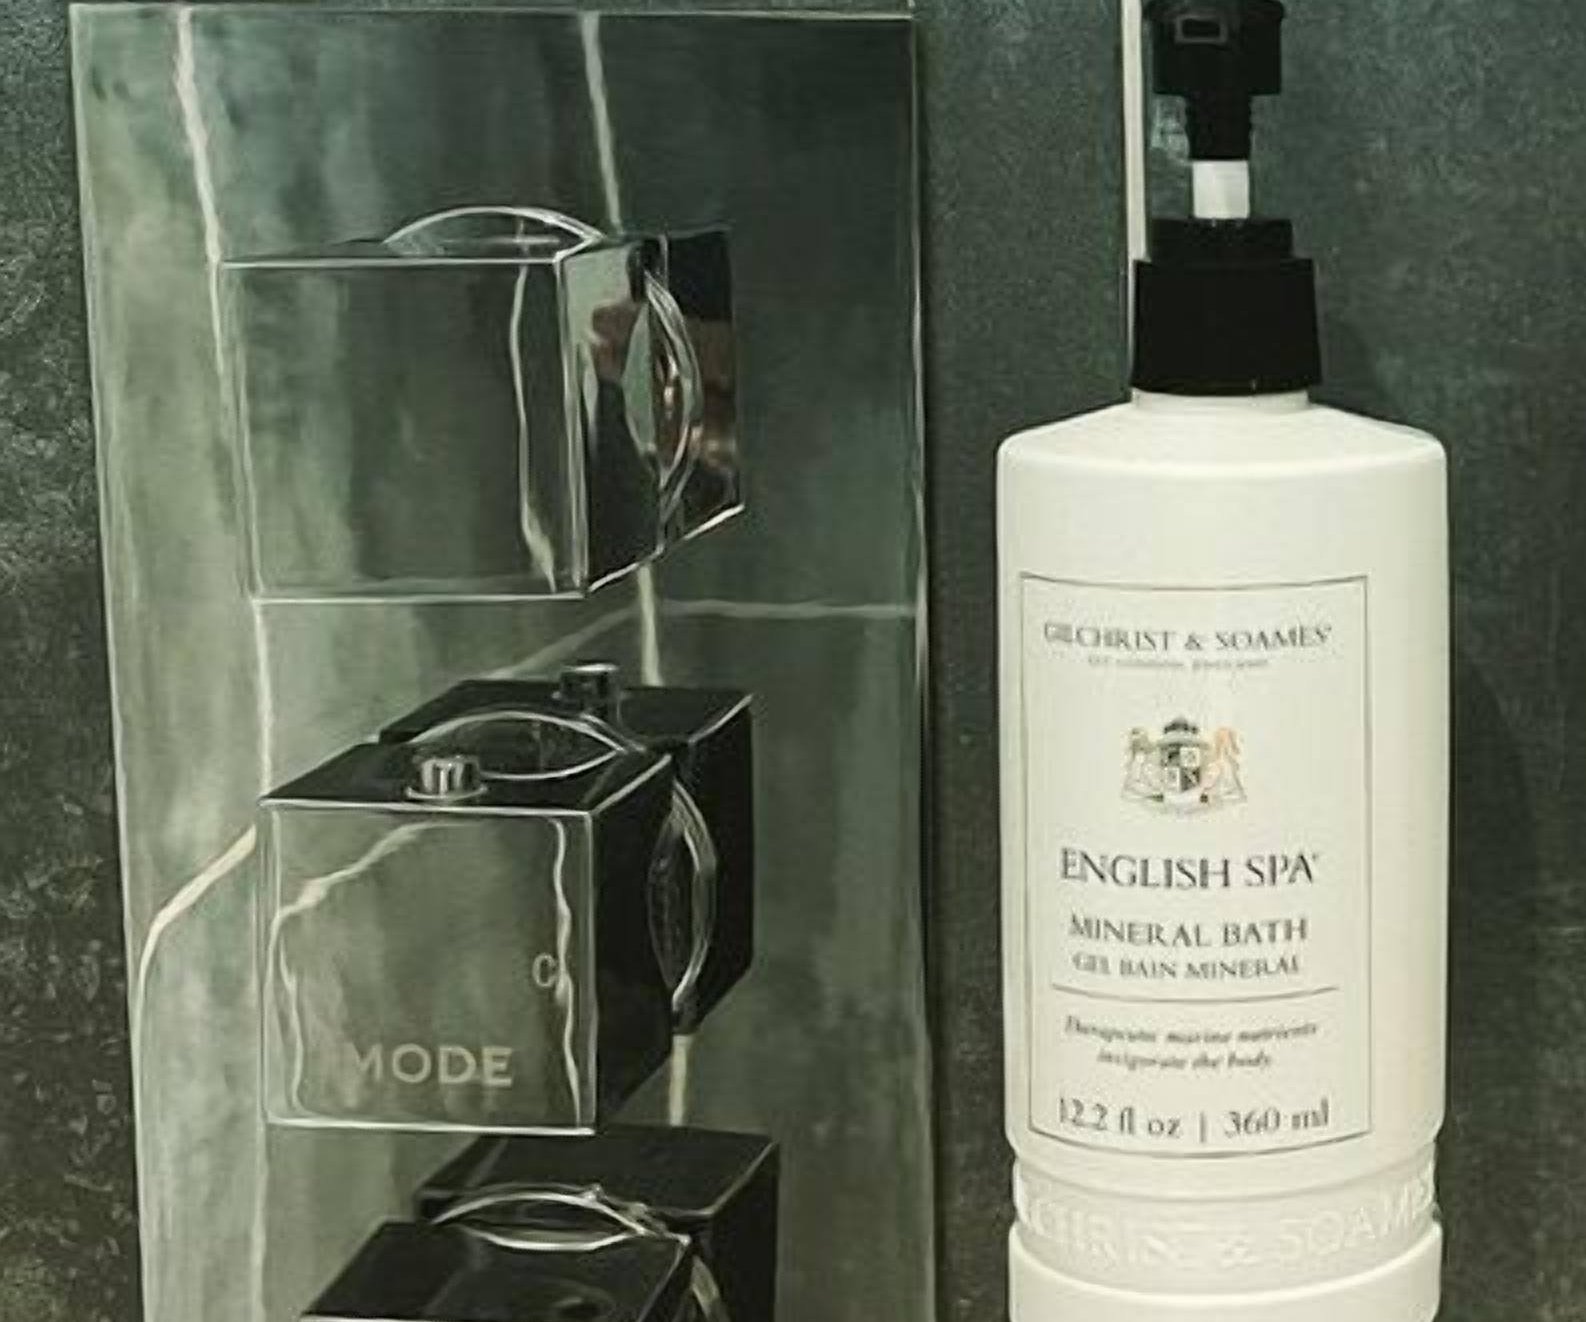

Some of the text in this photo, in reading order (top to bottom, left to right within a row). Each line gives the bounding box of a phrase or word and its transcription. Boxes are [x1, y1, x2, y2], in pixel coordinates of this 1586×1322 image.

[1044, 622, 1177, 652] GILCHRIST
[1184, 632, 1201, 651] &
[1060, 846, 1232, 890] ENGLISH
[1068, 912, 1309, 948] MINERAL BATH
[1119, 955, 1177, 979] BAIN
[346, 1042, 514, 1088] MODE
[1119, 1106, 1136, 1135] fl
[1147, 1117, 1181, 1138] oz
[1223, 1108, 1281, 1138] 360
[1291, 1096, 1330, 1129] ml
